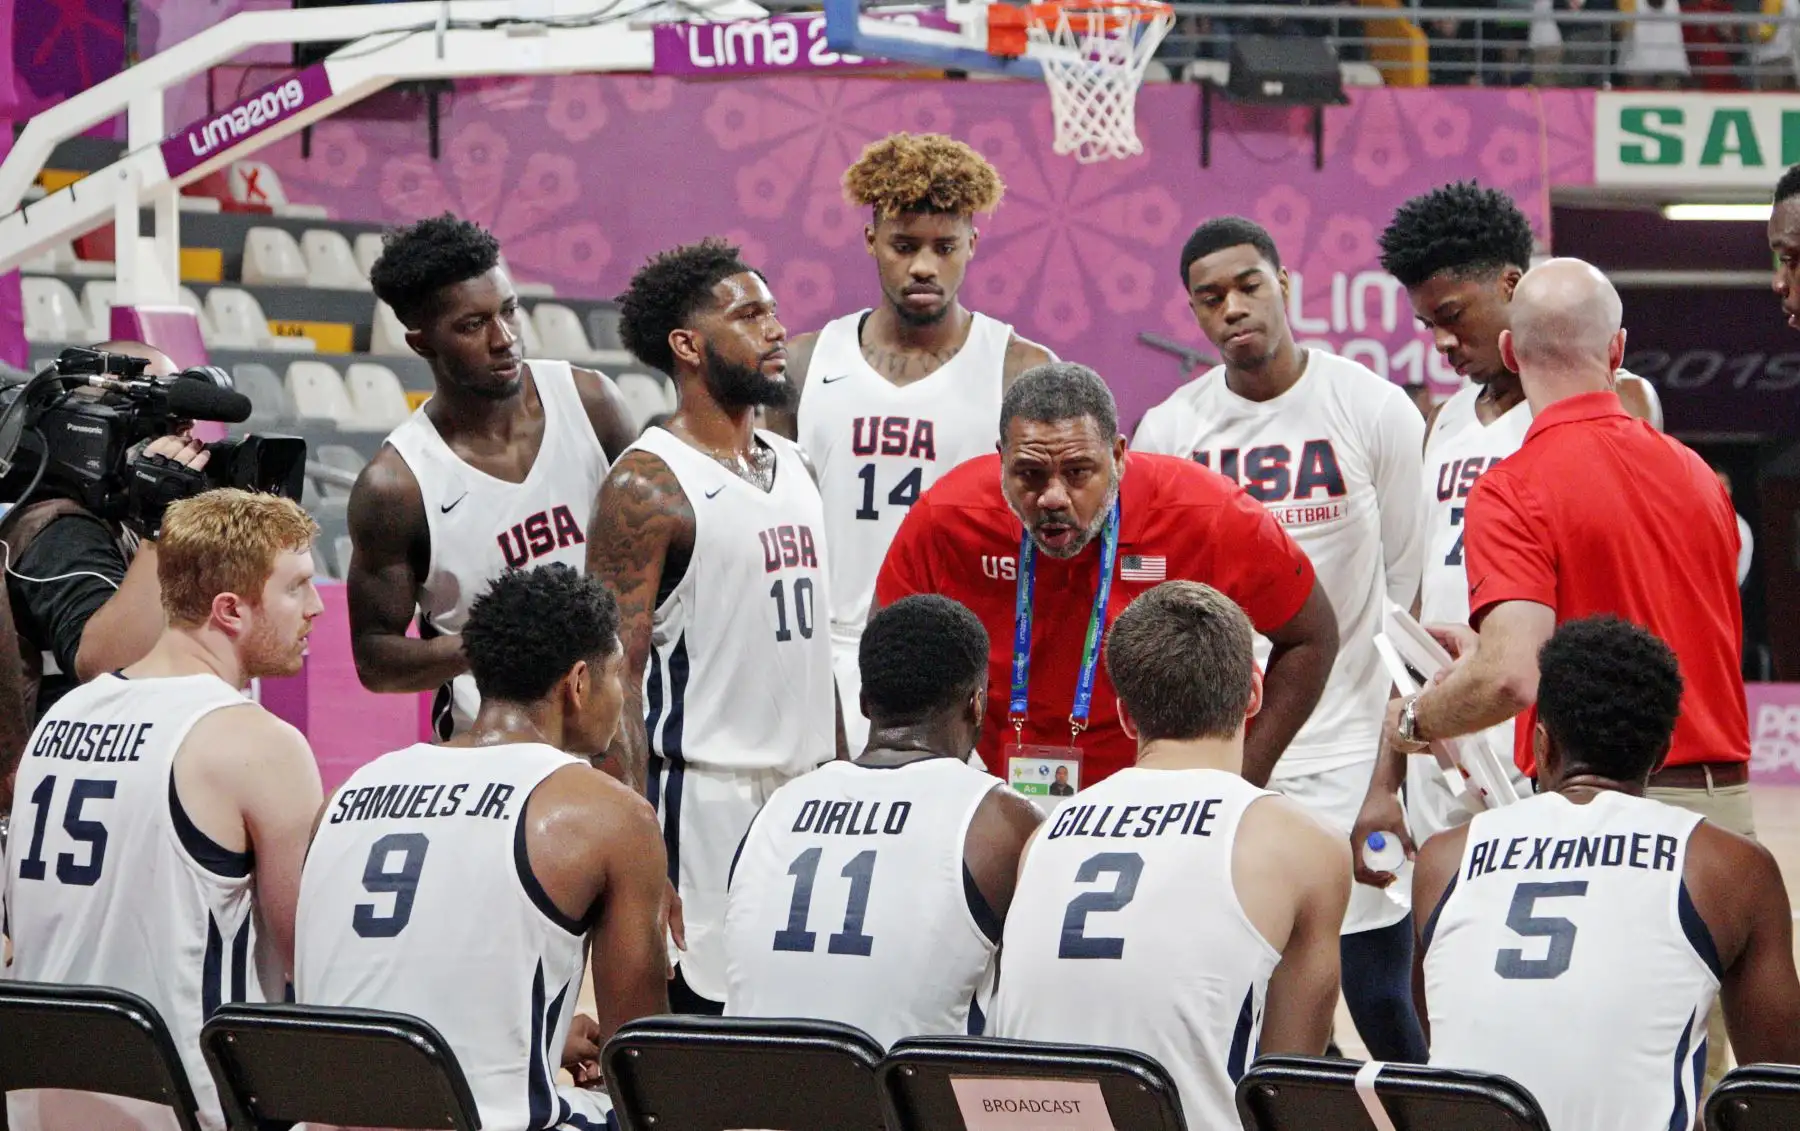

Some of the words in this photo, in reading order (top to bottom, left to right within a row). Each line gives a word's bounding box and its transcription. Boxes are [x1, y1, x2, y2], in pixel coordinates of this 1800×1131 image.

[1620, 107, 1800, 166] SA
[1289, 270, 1435, 334] Lim
[67, 422, 103, 435] Panasonic
[851, 415, 937, 462] USA
[857, 462, 922, 520] 14
[1436, 456, 1504, 503] US
[496, 503, 586, 569] USA
[1271, 503, 1341, 524] KETBALL
[758, 524, 818, 574] USA
[981, 554, 1020, 582] US
[770, 577, 814, 642] 10
[32, 719, 154, 763] GROSELLE
[329, 783, 470, 825] SAMUELS
[465, 782, 516, 821] JR.
[791, 799, 913, 836] DIALLO
[1047, 798, 1223, 840] GILLESPIE
[19, 774, 118, 887] 15
[1466, 832, 1679, 881] ALEXANDER
[351, 832, 430, 938] 9
[772, 847, 878, 957] 11
[1058, 852, 1145, 960] 2
[1494, 880, 1590, 980] 5
[982, 1098, 1082, 1115] BROADCAST
